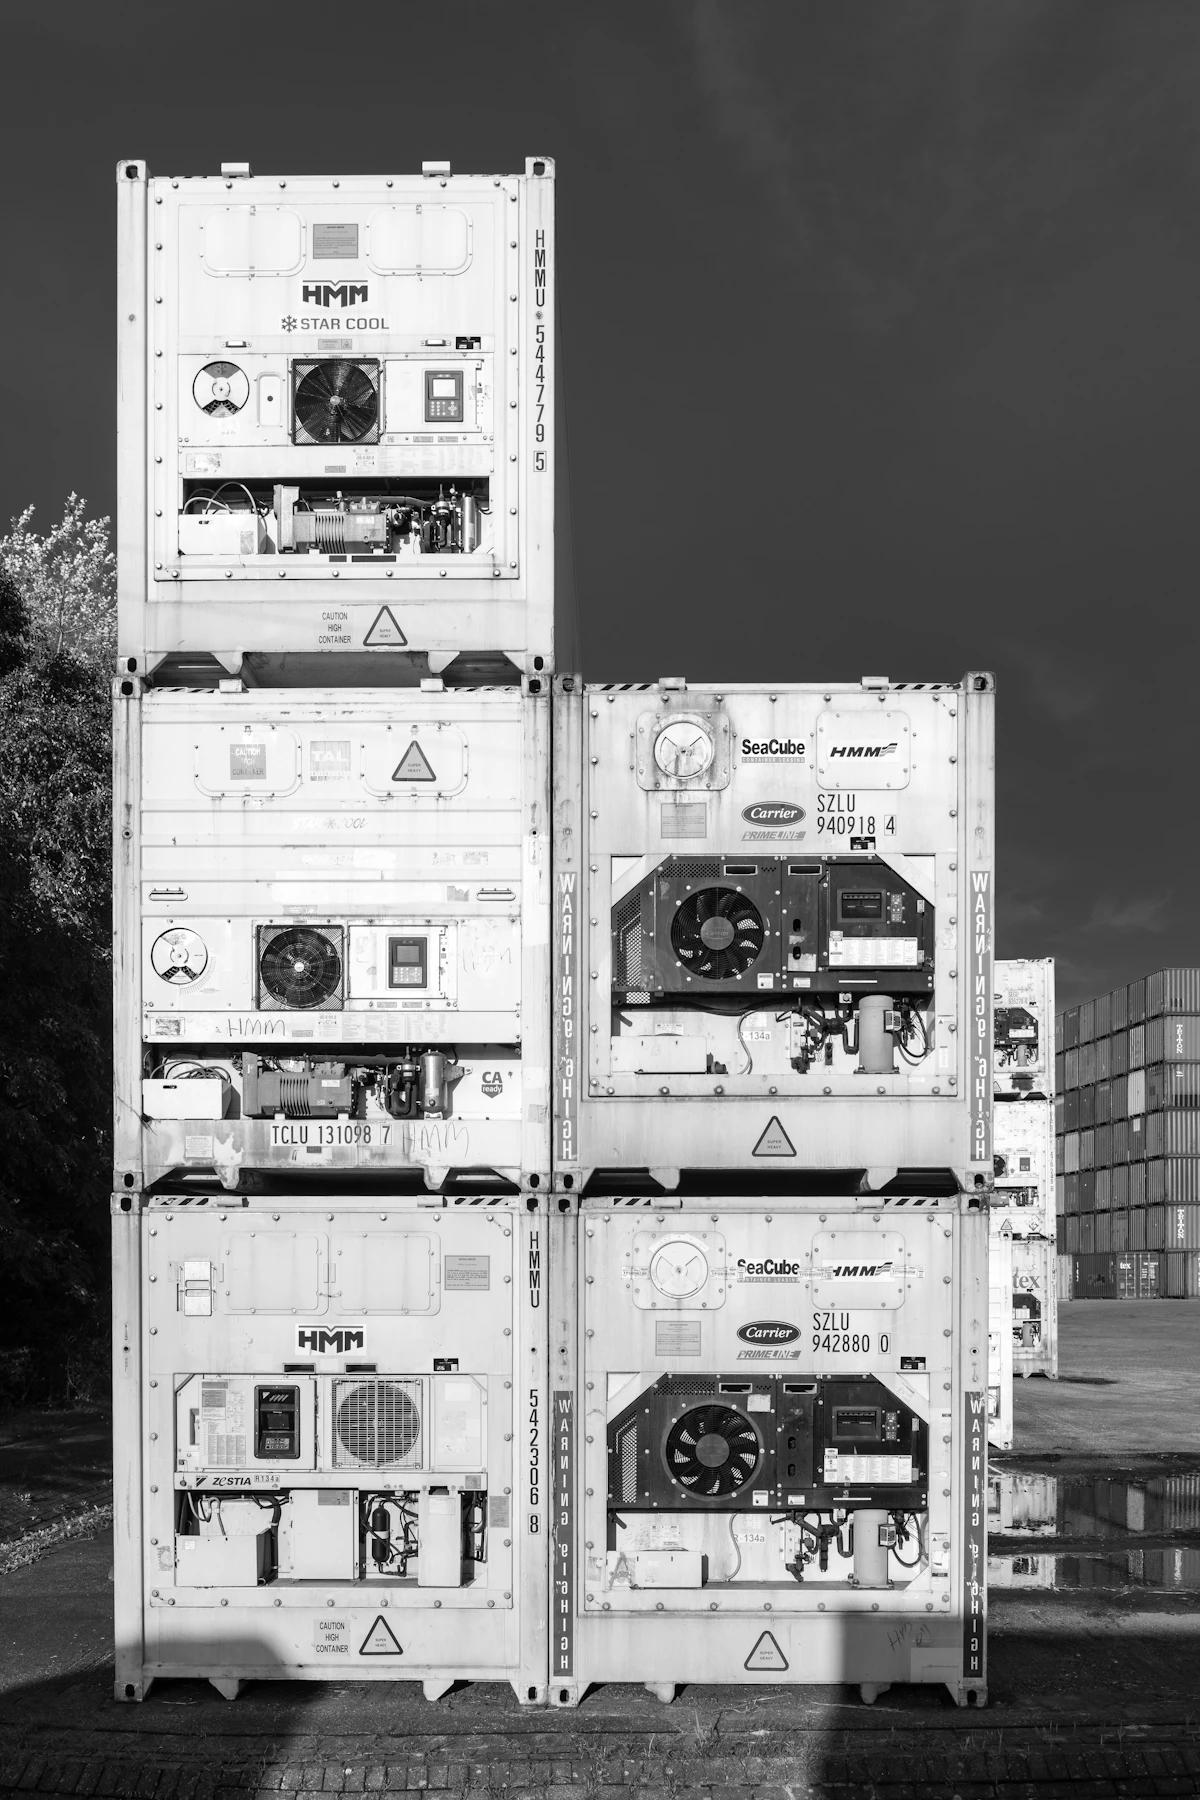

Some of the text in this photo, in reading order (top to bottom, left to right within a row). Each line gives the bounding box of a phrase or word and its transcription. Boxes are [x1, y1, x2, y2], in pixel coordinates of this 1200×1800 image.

[303, 285, 368, 308] HMM
[301, 318, 389, 329] STAR COOL
[535, 229, 545, 471] HMMU 544779 5
[322, 612, 348, 620] CAUTION
[328, 624, 342, 632] HIGH
[319, 635, 351, 644] CONTAINER
[235, 748, 261, 757] CAUTION
[742, 739, 805, 755] SeaCube
[830, 746, 884, 757] HMM
[312, 750, 348, 762] TAL
[817, 794, 855, 812] SZLU
[751, 808, 797, 819] Carrier
[817, 817, 895, 835] 940918 4
[227, 1018, 286, 1037] HMM
[482, 1071, 503, 1083] CA
[482, 1085, 502, 1093] ready
[272, 1125, 391, 1144] TCLU 131098 7
[1012, 1266, 1041, 1288] tex
[813, 1313, 850, 1331] SZLU
[746, 1327, 792, 1338] Carrier
[299, 1331, 363, 1353] HMM
[813, 1335, 889, 1353] 942880 0
[529, 1231, 540, 1533] HMMU 542306 8
[320, 1622, 345, 1630] CAUTION
[326, 1634, 340, 1642] HIGH
[316, 1645, 349, 1653] CONTAINER
